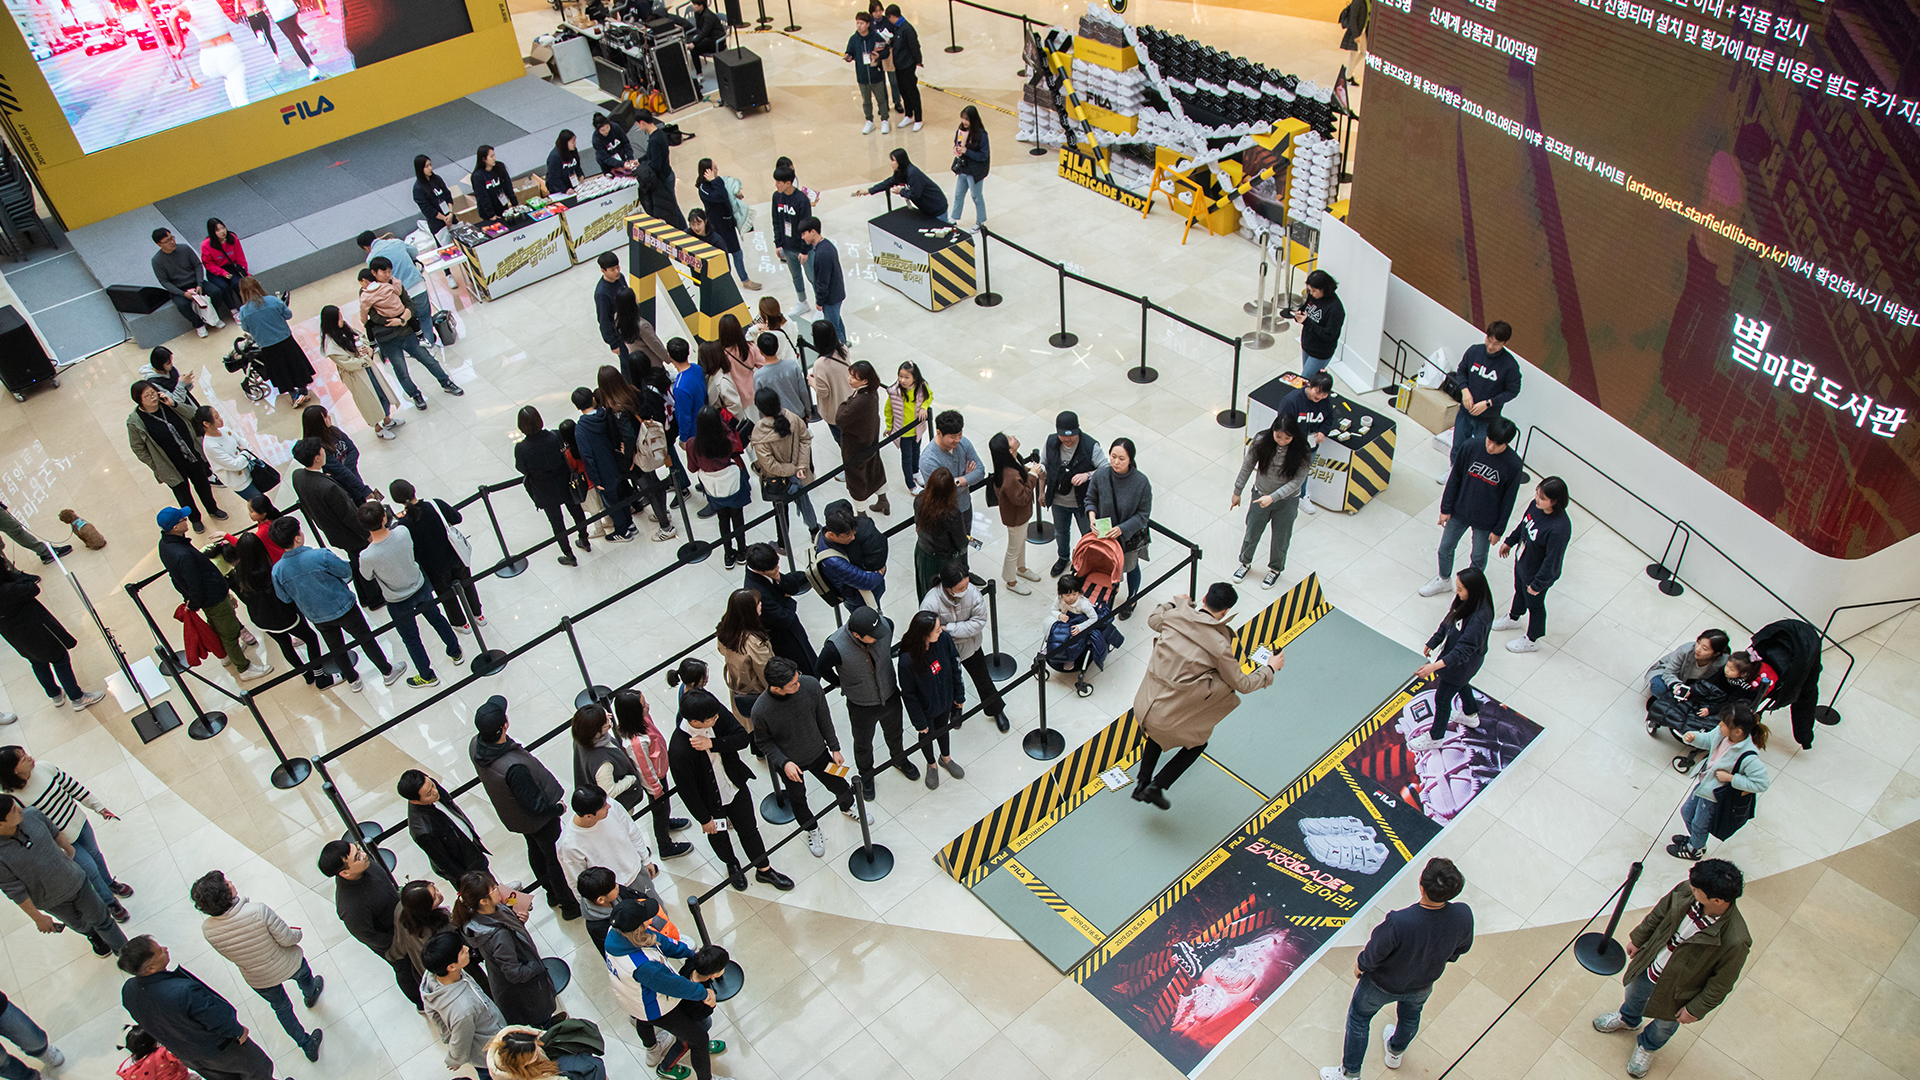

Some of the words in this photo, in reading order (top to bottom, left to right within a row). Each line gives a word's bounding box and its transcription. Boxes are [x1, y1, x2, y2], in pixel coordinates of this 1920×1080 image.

[1429, 6, 1461, 34] 신세계
[1461, 19, 1495, 47] 상품권
[1495, 33, 1538, 66] 100만원
[1738, 4, 1773, 35] 작품
[1774, 16, 1810, 47] 전시
[1655, 12, 1684, 39] 설치
[1684, 22, 1700, 45] 및
[1700, 28, 1745, 61] 철거에
[1744, 45, 1776, 72] 따른
[1776, 56, 1824, 90] 비용은
[1825, 73, 1859, 101] 별도
[1860, 86, 1897, 116] 추가
[1897, 99, 1920, 127] 지
[280, 95, 335, 125] FILA
[1086, 91, 1113, 110] FILA
[1059, 147, 1093, 178] FILA
[1058, 164, 1118, 200] BARRICADE
[1413, 74, 1422, 90] 및
[1461, 98, 1484, 120] 2019.
[1484, 109, 1524, 140] 03.08(금)
[1524, 128, 1544, 147] 이후
[1544, 135, 1574, 162] 공모전
[1574, 150, 1595, 172] 안내
[1594, 161, 1626, 186] 사이트
[1815, 267, 1883, 312] 확인하시기
[777, 203, 796, 216] FILA
[1470, 362, 1498, 382] FILA
[1297, 412, 1325, 423] FILA
[1468, 461, 1501, 484] FILA
[1523, 513, 1539, 541] FILA
[1409, 681, 1425, 693] FILA
[1380, 695, 1406, 719] BARRICADE
[1266, 804, 1283, 818] FILA
[1373, 789, 1397, 809] FILA
[1016, 821, 1050, 848] BARRICADE
[1228, 836, 1246, 850] FILA
[990, 851, 1009, 865] FILA
[1190, 853, 1223, 881] BARRICADE
[1009, 864, 1026, 879] FILA
[1302, 881, 1358, 911] 넘어라!
[1114, 917, 1148, 947] 2019.03.16.SAT
